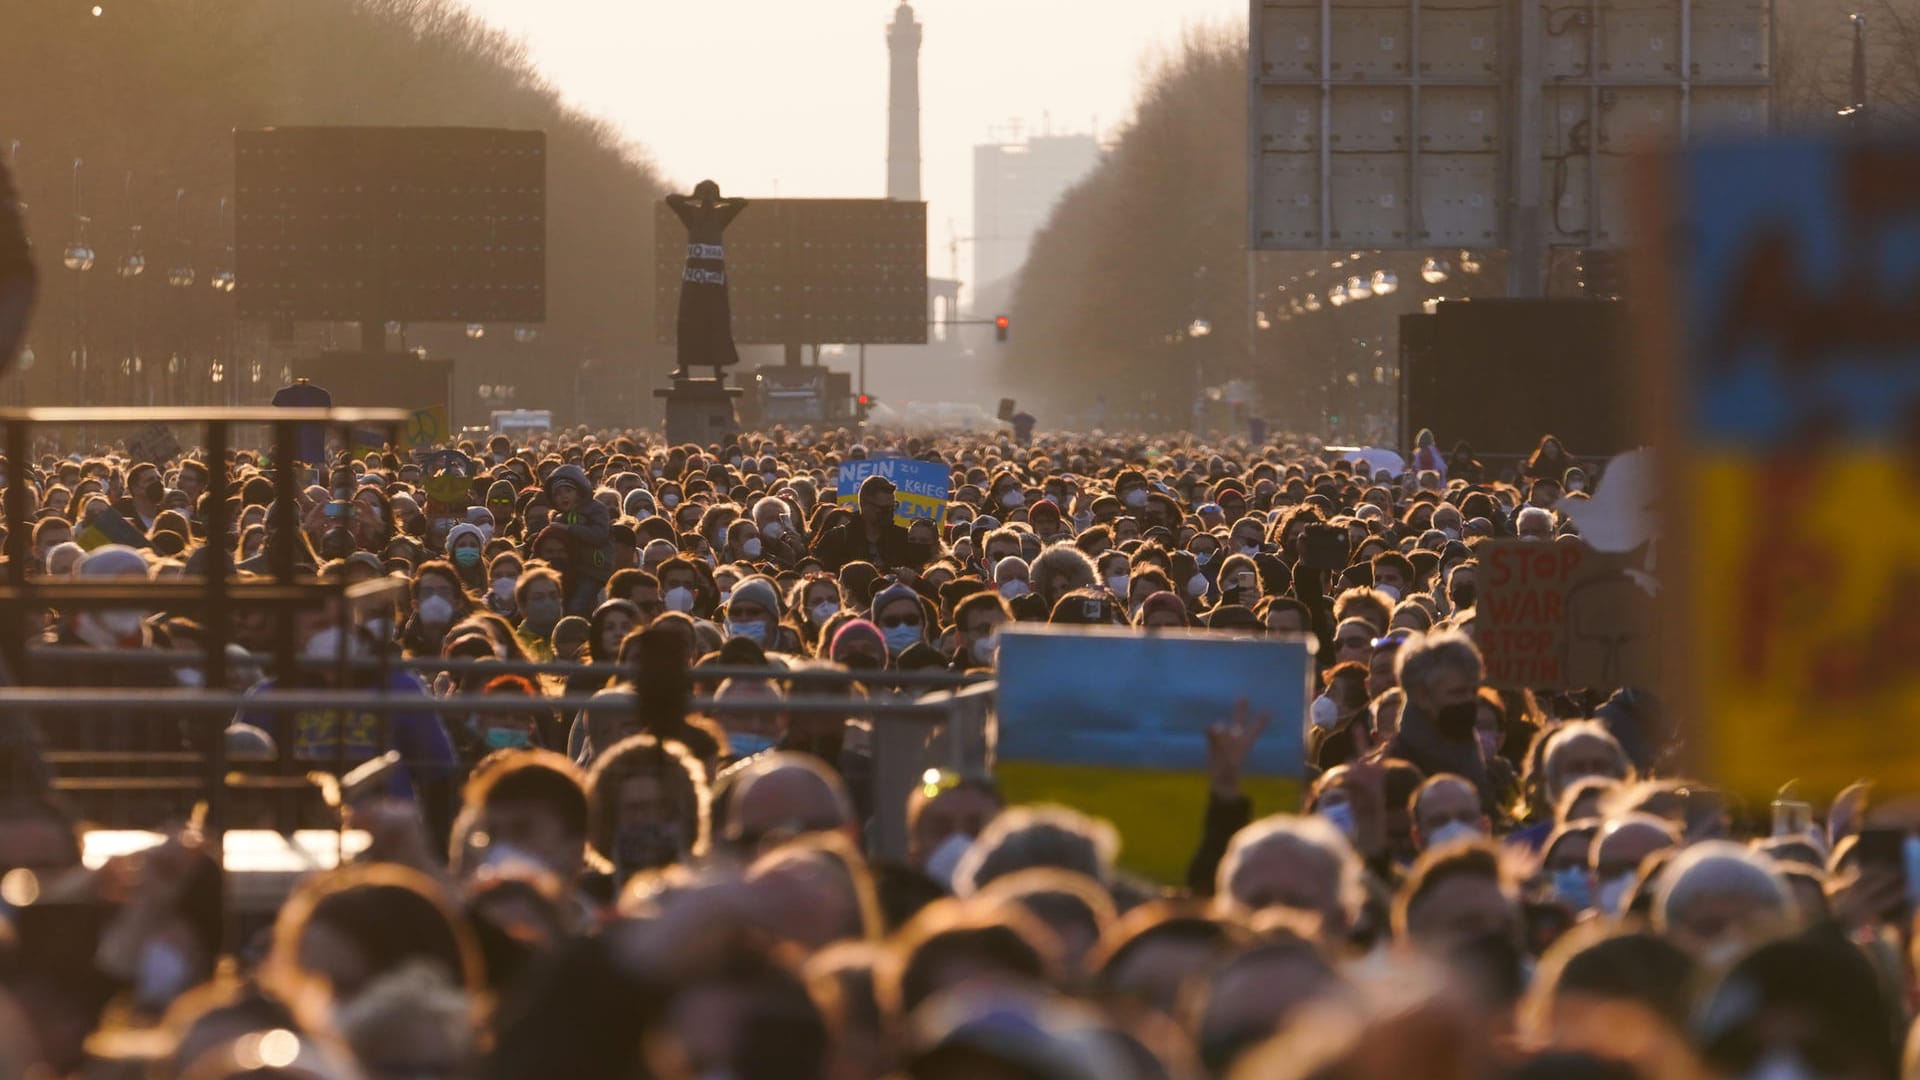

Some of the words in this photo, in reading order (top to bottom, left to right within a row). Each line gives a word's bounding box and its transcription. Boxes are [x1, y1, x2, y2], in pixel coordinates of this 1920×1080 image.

[839, 461, 895, 483] NEIN
[905, 480, 945, 498] KRIEG
[1488, 545, 1582, 587] STOP
[1483, 589, 1564, 625] WAR
[1480, 627, 1554, 657] STOP
